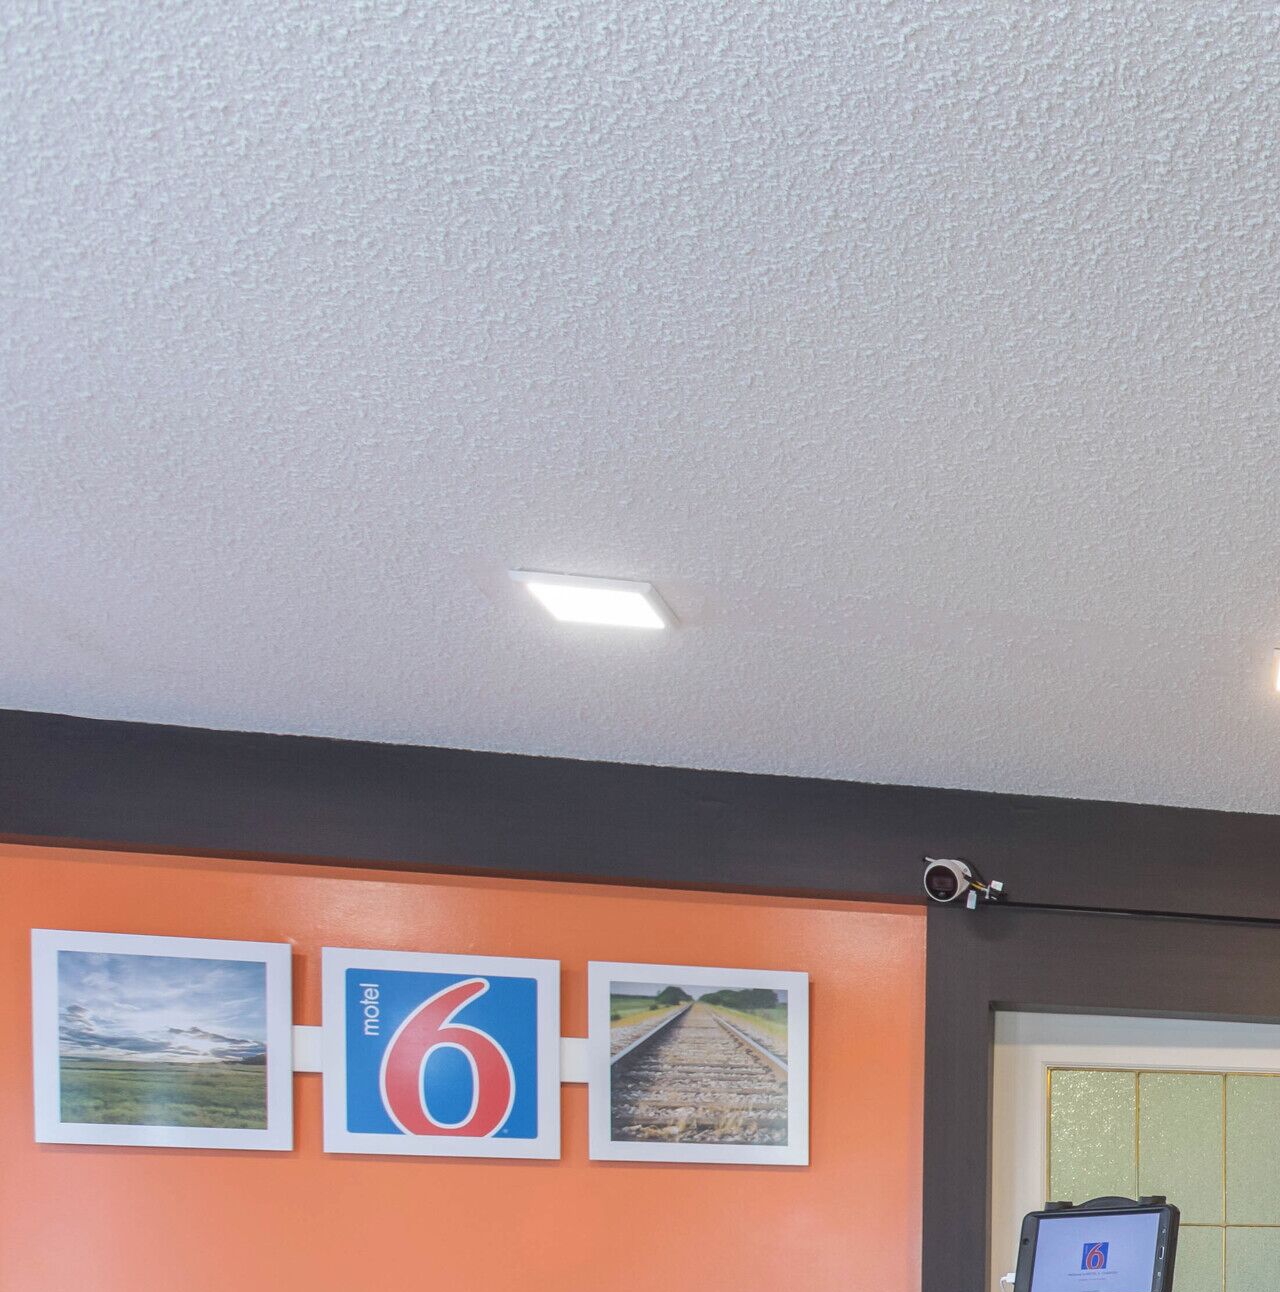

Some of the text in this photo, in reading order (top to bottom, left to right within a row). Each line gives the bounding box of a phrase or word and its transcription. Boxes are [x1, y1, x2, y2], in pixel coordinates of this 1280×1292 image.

[359, 983, 380, 1036] motel
[379, 977, 516, 1138] 6
[1085, 1241, 1105, 1270] 6
